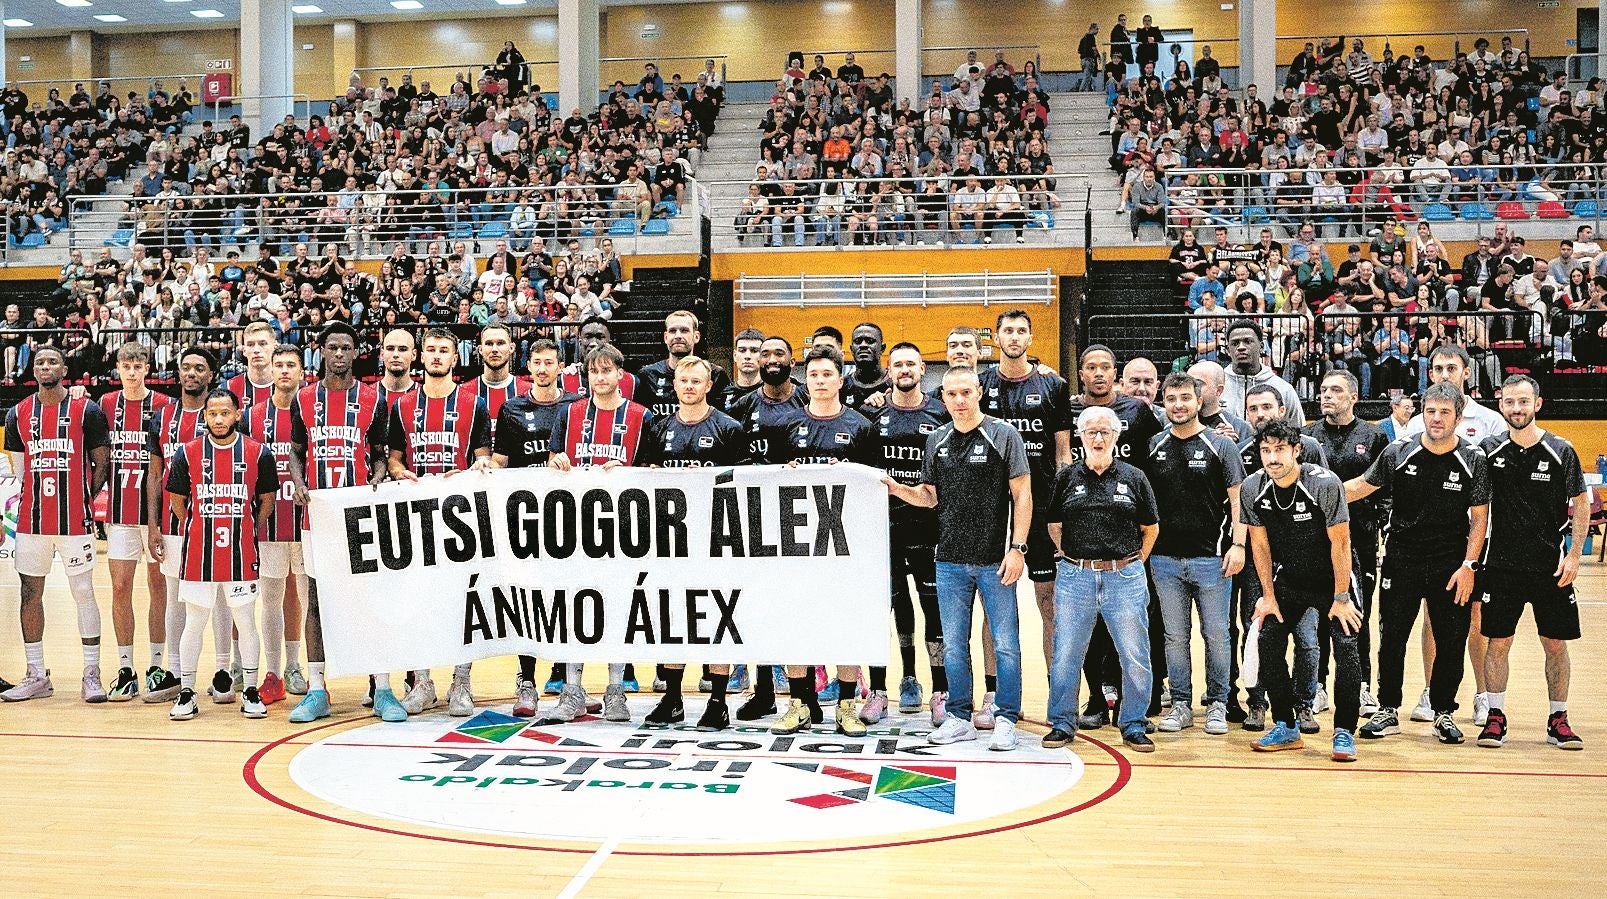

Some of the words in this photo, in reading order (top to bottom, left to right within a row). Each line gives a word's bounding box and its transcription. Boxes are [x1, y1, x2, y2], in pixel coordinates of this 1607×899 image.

[43, 477, 56, 497] 6
[117, 468, 145, 489] 77
[325, 467, 348, 489] 17
[343, 490, 496, 575] EUTSI
[506, 488, 689, 560] GOGOR
[709, 468, 851, 557] ÁLEX
[215, 526, 230, 548] 3
[463, 573, 605, 645] ÁNIMO
[624, 572, 744, 645] ÁLEX
[398, 774, 742, 794] Barakaldo
